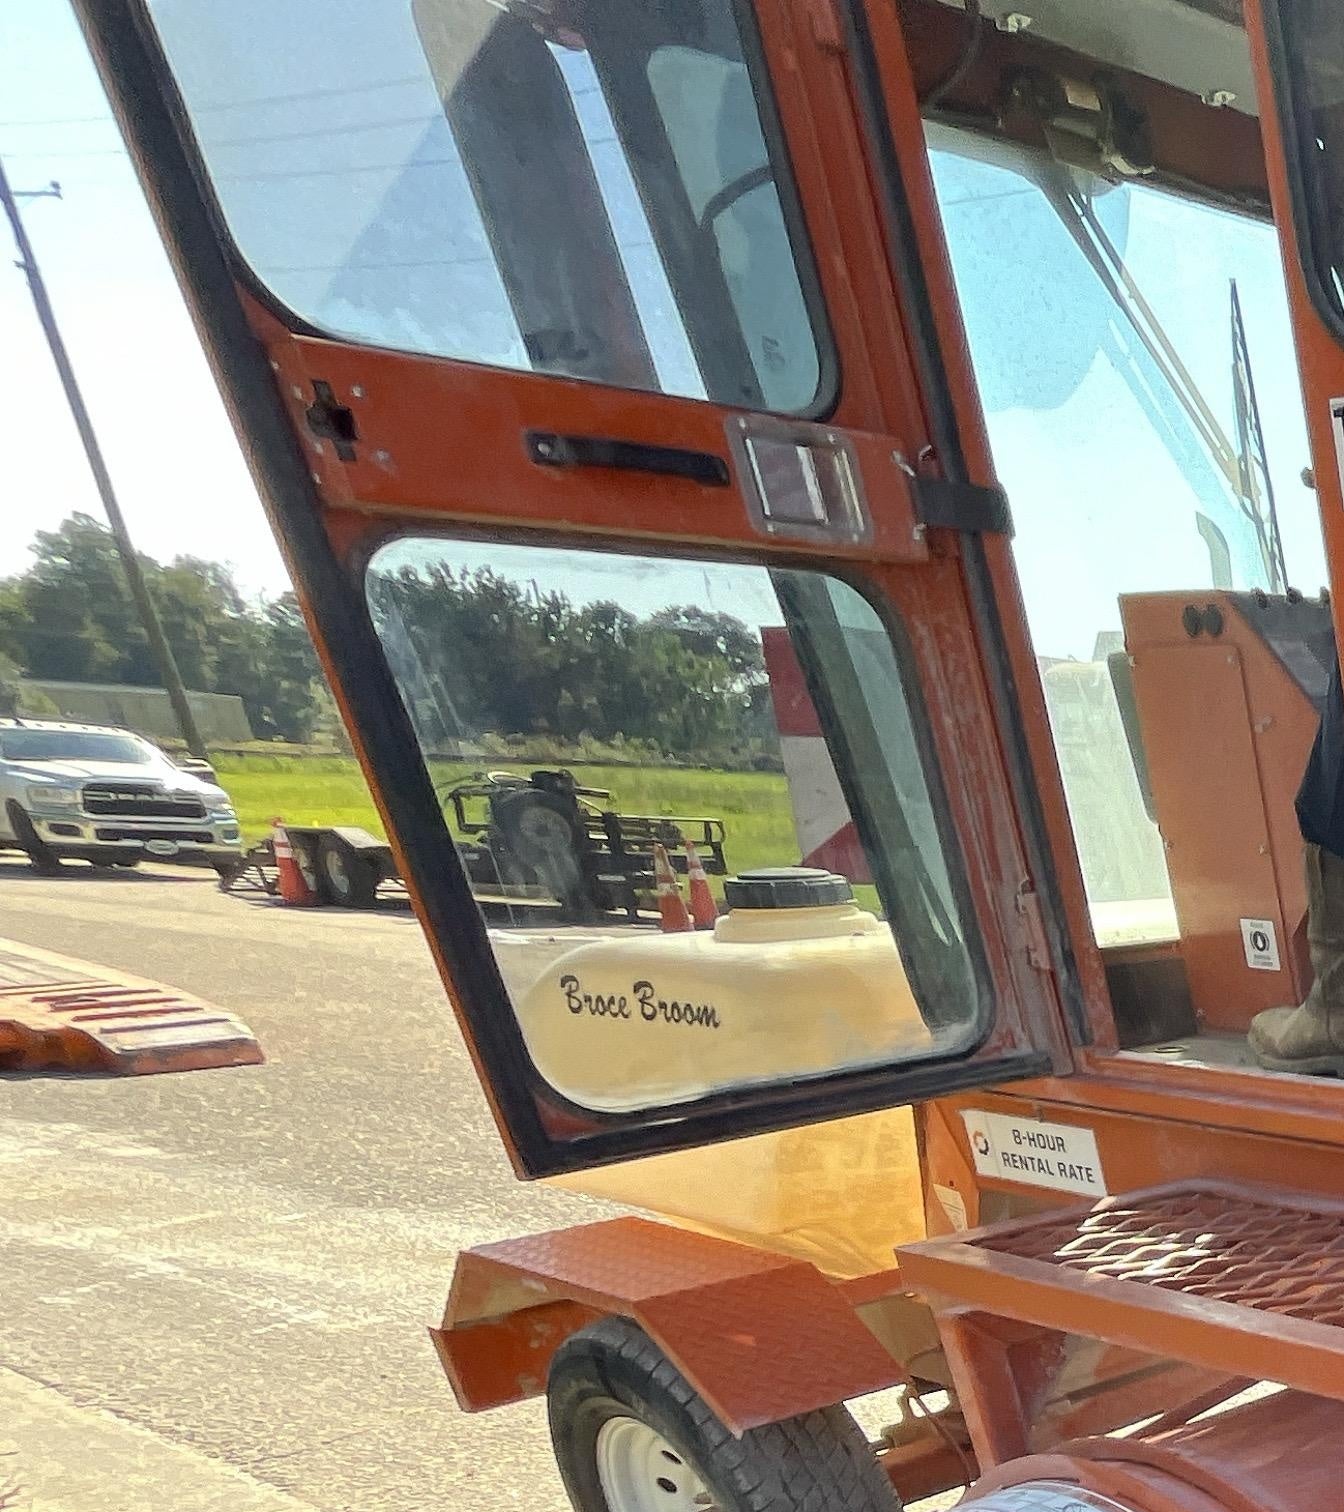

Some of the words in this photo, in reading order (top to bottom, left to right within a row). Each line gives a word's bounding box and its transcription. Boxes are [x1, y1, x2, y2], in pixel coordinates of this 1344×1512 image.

[560, 975, 631, 1018] Broce
[633, 980, 720, 1029] Broom
[1012, 1129, 1067, 1153] 8-HOUR
[1001, 1152, 1054, 1176] RENTAL
[1058, 1162, 1095, 1184] RATE
